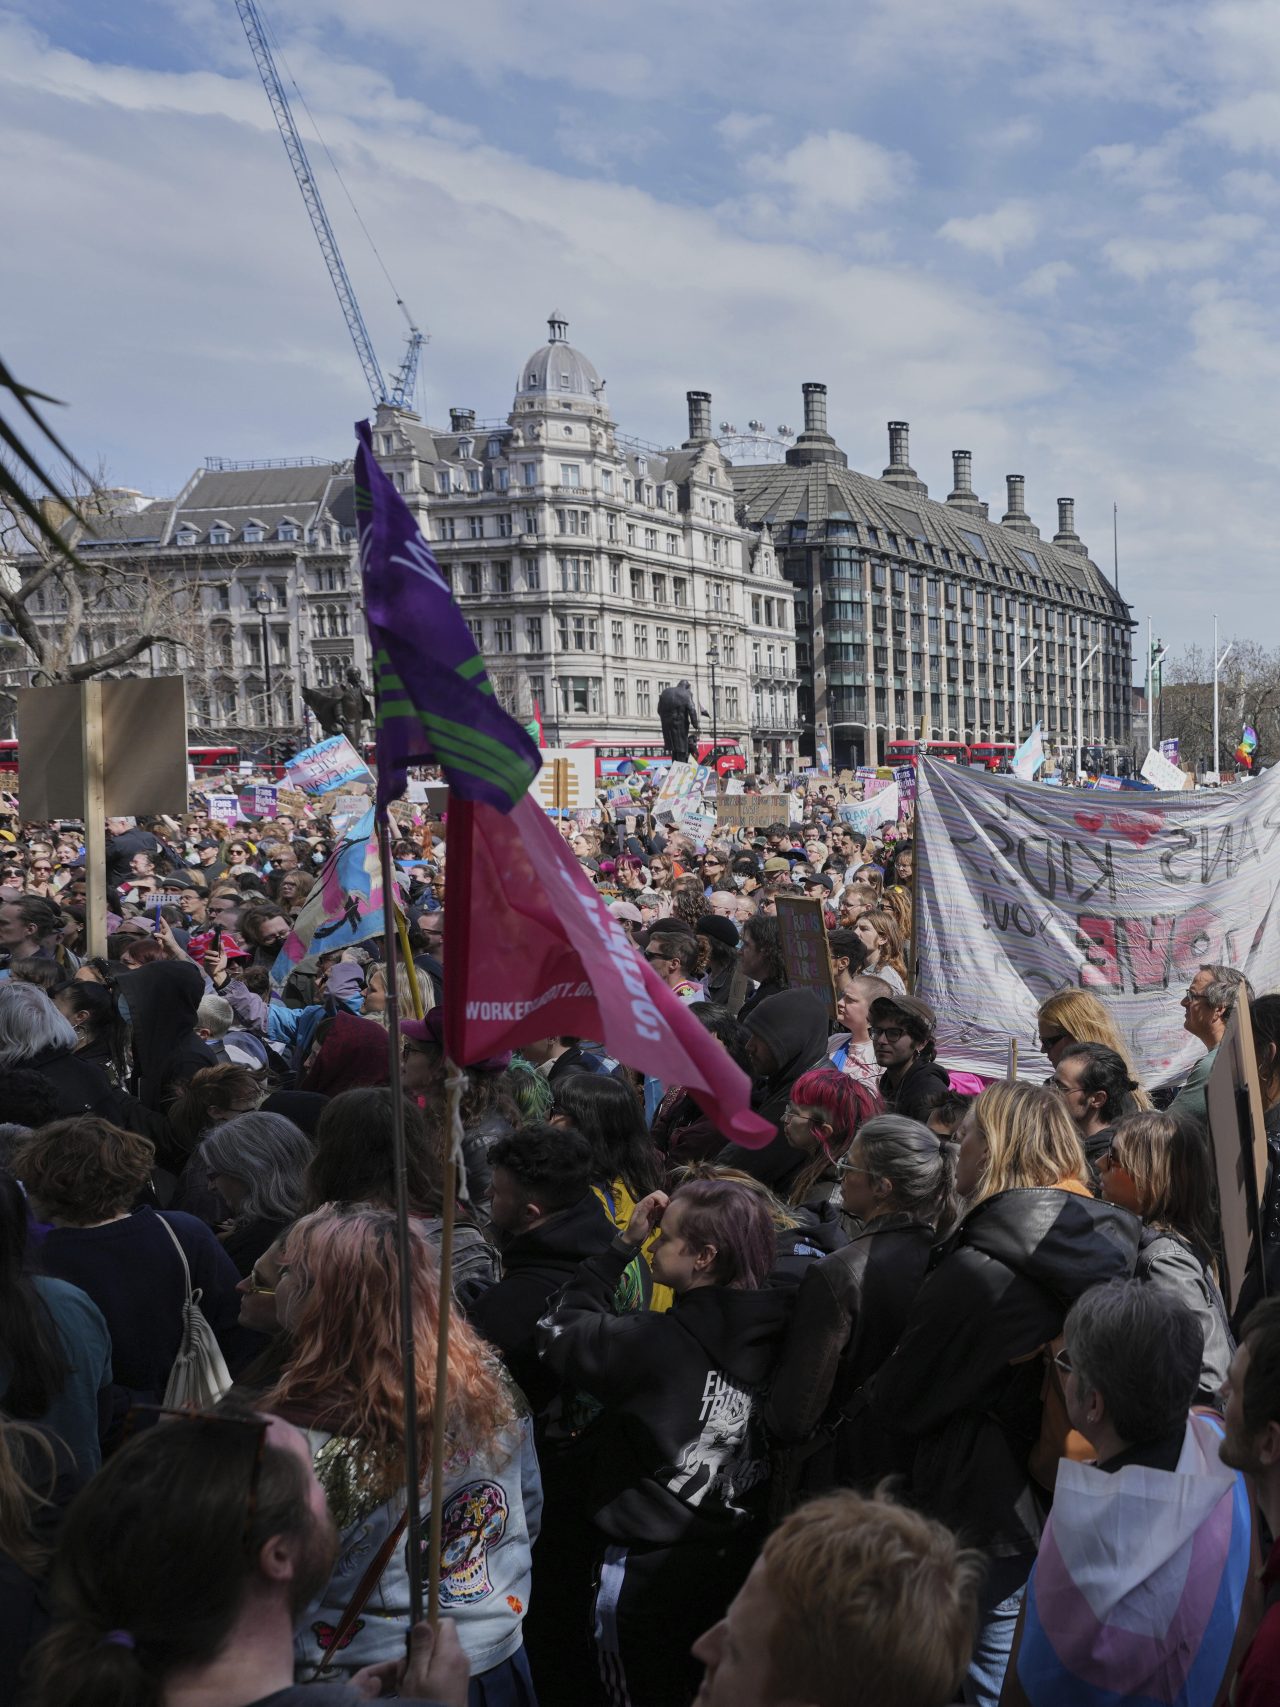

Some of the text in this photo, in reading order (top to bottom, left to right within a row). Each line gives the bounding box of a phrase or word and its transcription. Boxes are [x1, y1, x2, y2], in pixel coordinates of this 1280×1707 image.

[893, 770, 911, 780] Trans
[210, 800, 232, 808] Trans
[210, 807, 237, 817] Rights
